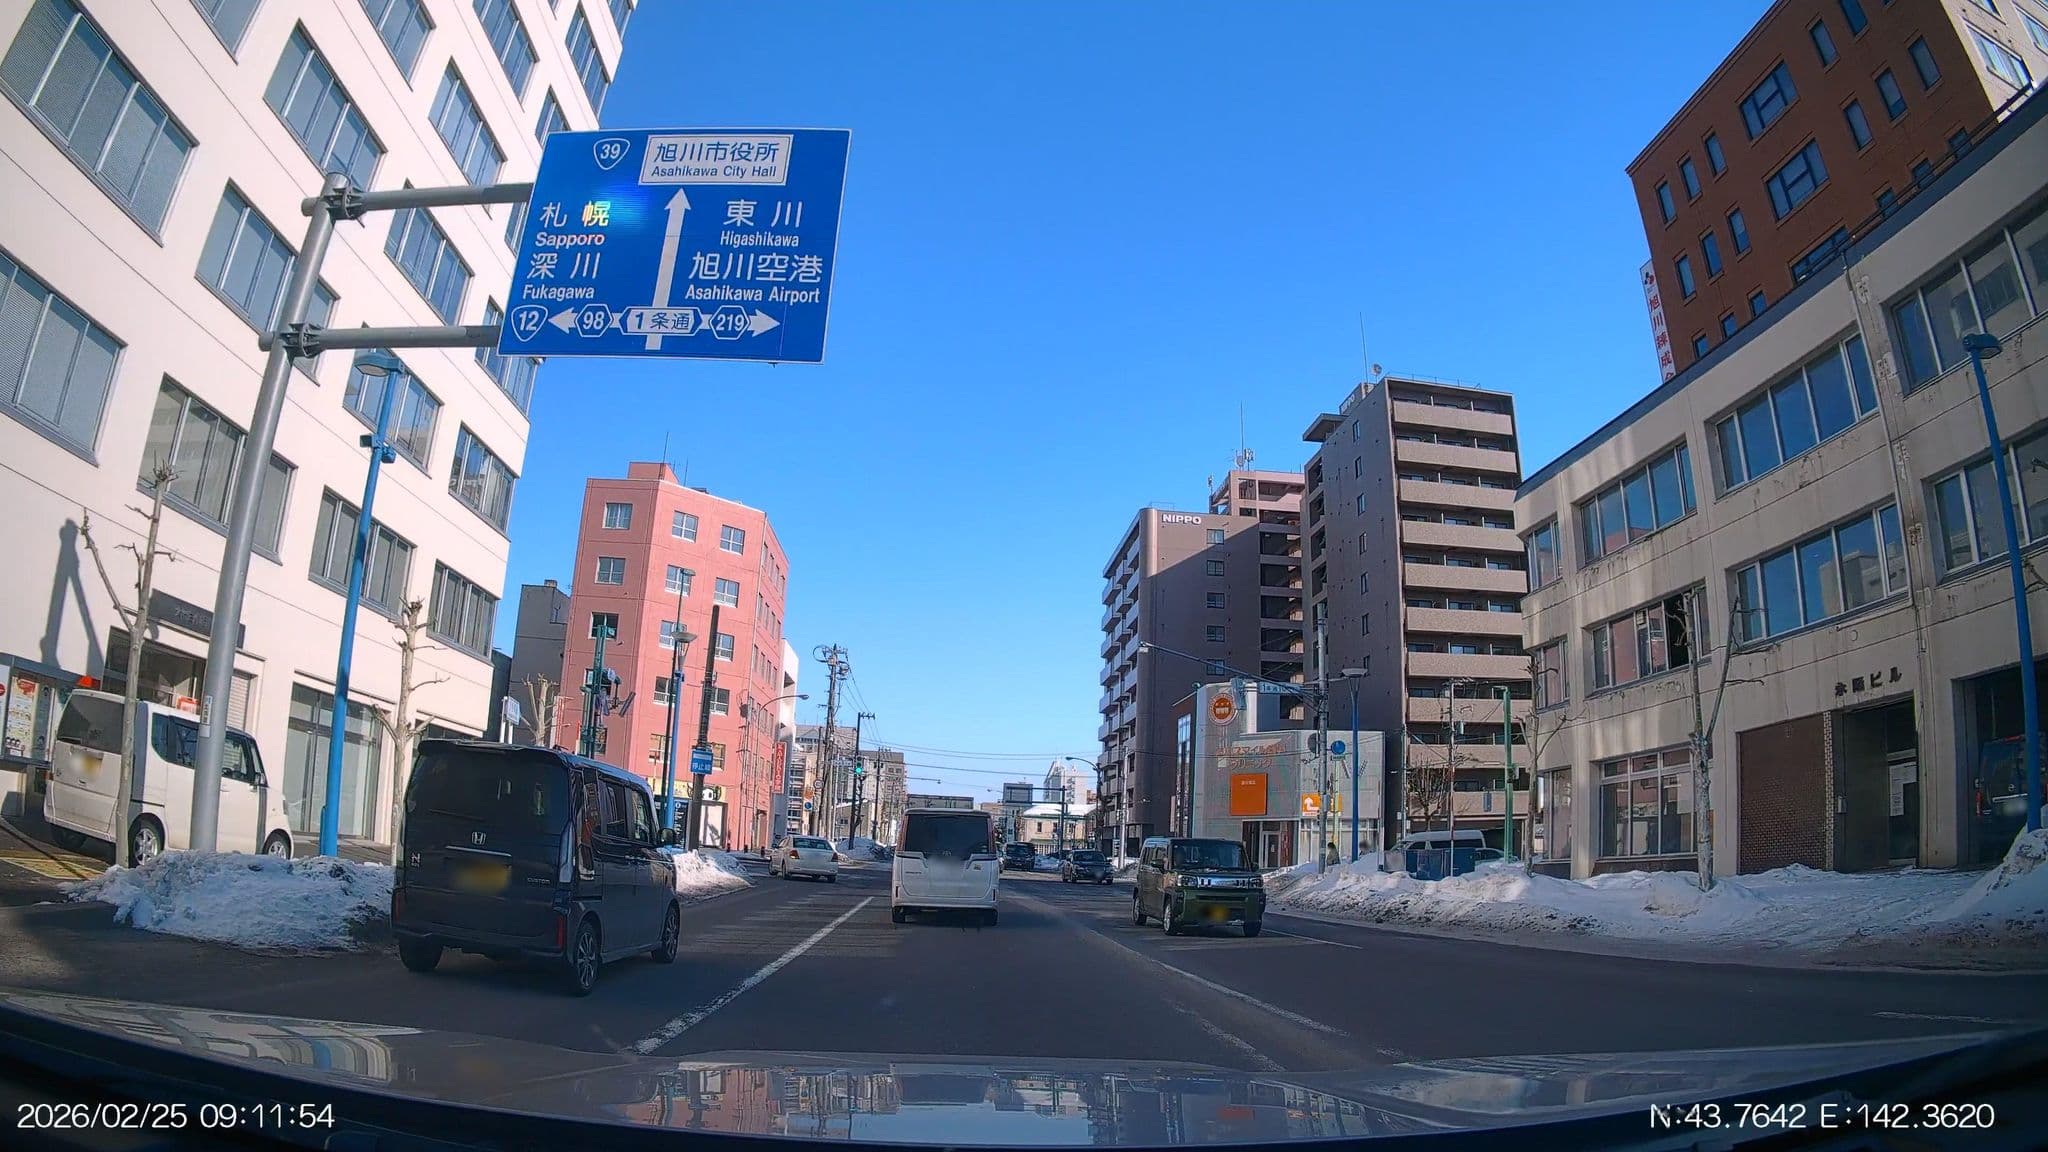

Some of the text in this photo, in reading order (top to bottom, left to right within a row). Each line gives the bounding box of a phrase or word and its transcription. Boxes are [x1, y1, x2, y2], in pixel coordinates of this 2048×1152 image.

[600, 143, 620, 159] 39
[653, 142, 780, 163] 旭川市役所
[651, 165, 776, 179] Asahikawa City Hall
[539, 200, 610, 228] 札幌
[723, 199, 802, 228] 東川
[535, 232, 605, 249] Sapporo
[720, 230, 799, 248] Higashikawa
[527, 252, 600, 280] 深川
[689, 252, 823, 283] 旭川空港
[523, 284, 595, 301] Fukagawa
[685, 286, 820, 305] Asahikawa Airport
[516, 311, 539, 330] 12
[583, 312, 604, 329] 98
[717, 313, 745, 331] 219
[1162, 513, 1202, 525] NIPPO
